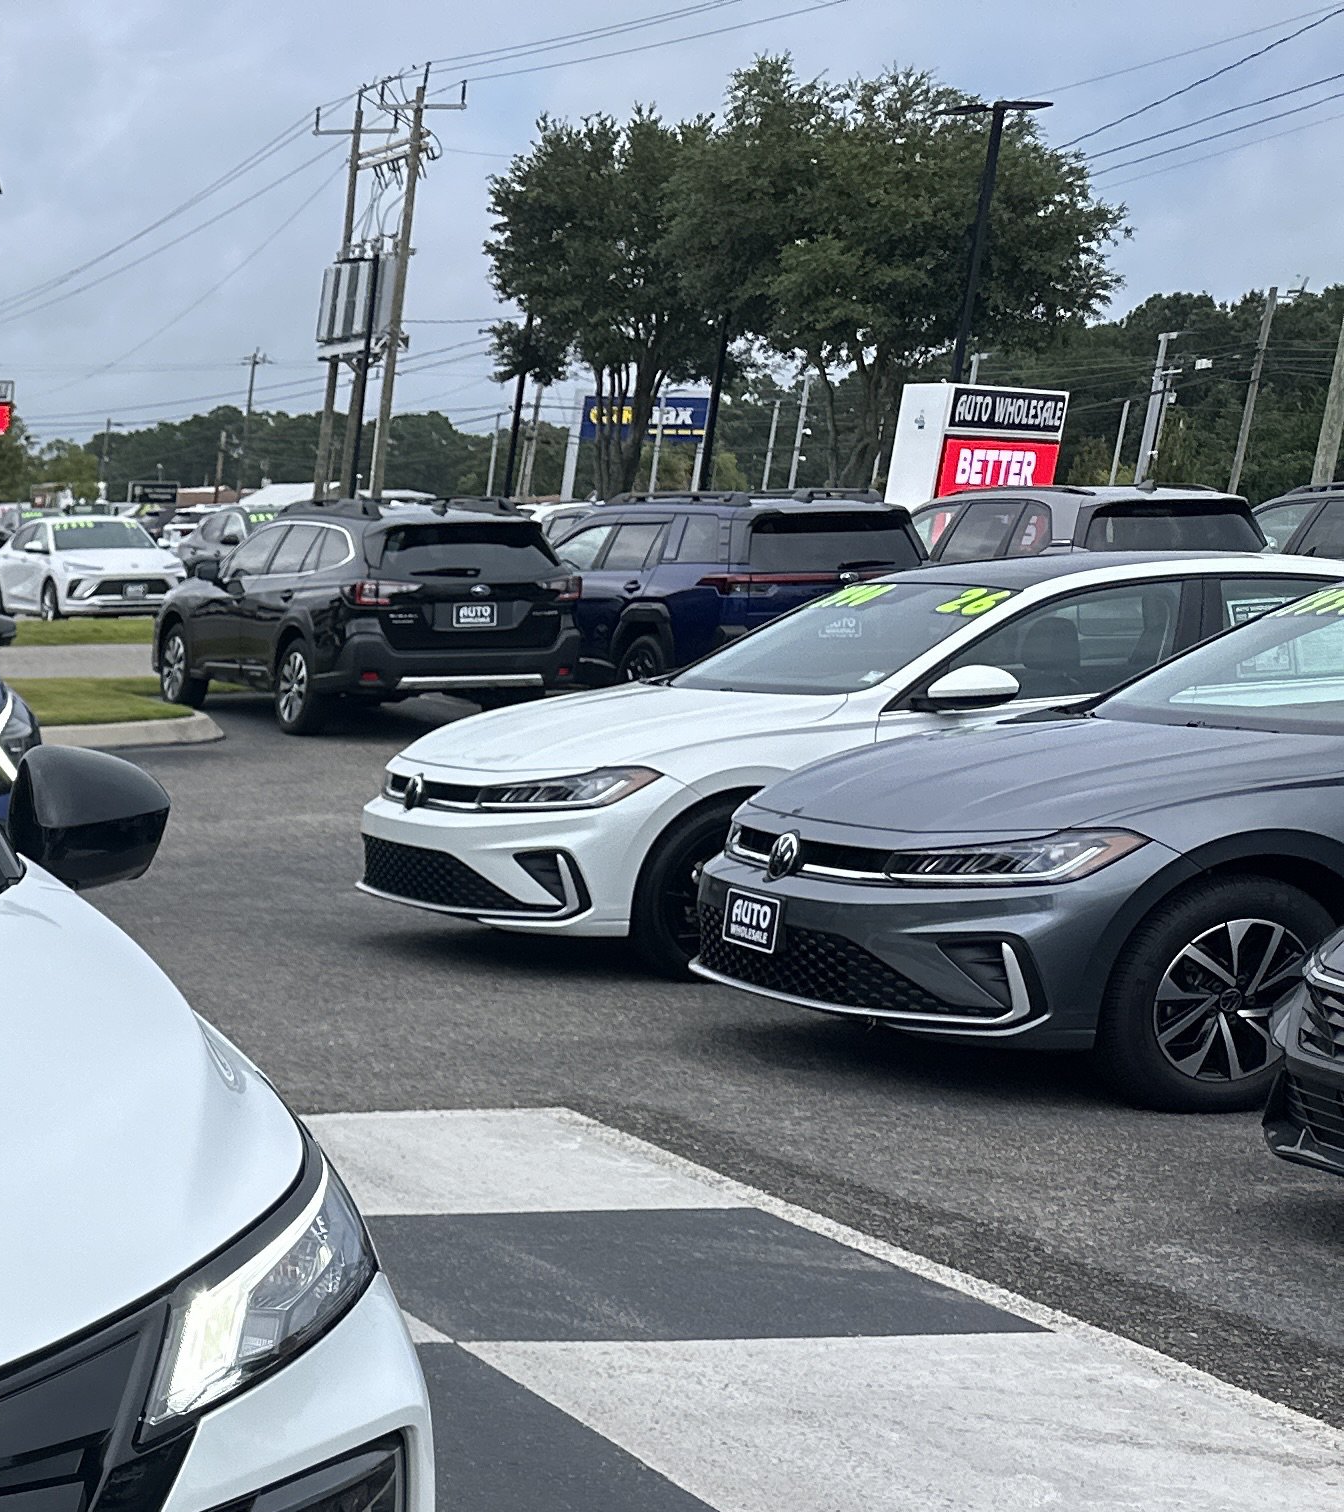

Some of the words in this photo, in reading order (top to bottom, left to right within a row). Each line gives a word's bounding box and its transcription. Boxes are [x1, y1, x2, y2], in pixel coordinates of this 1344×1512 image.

[955, 395, 993, 423] AUTO
[994, 396, 1064, 428] WHOLESALE
[955, 448, 1037, 487] BETTER
[459, 605, 491, 618] AUTO
[935, 587, 1011, 616] 26
[732, 898, 772, 930] AUTO
[730, 922, 769, 945] WHOLESALE
